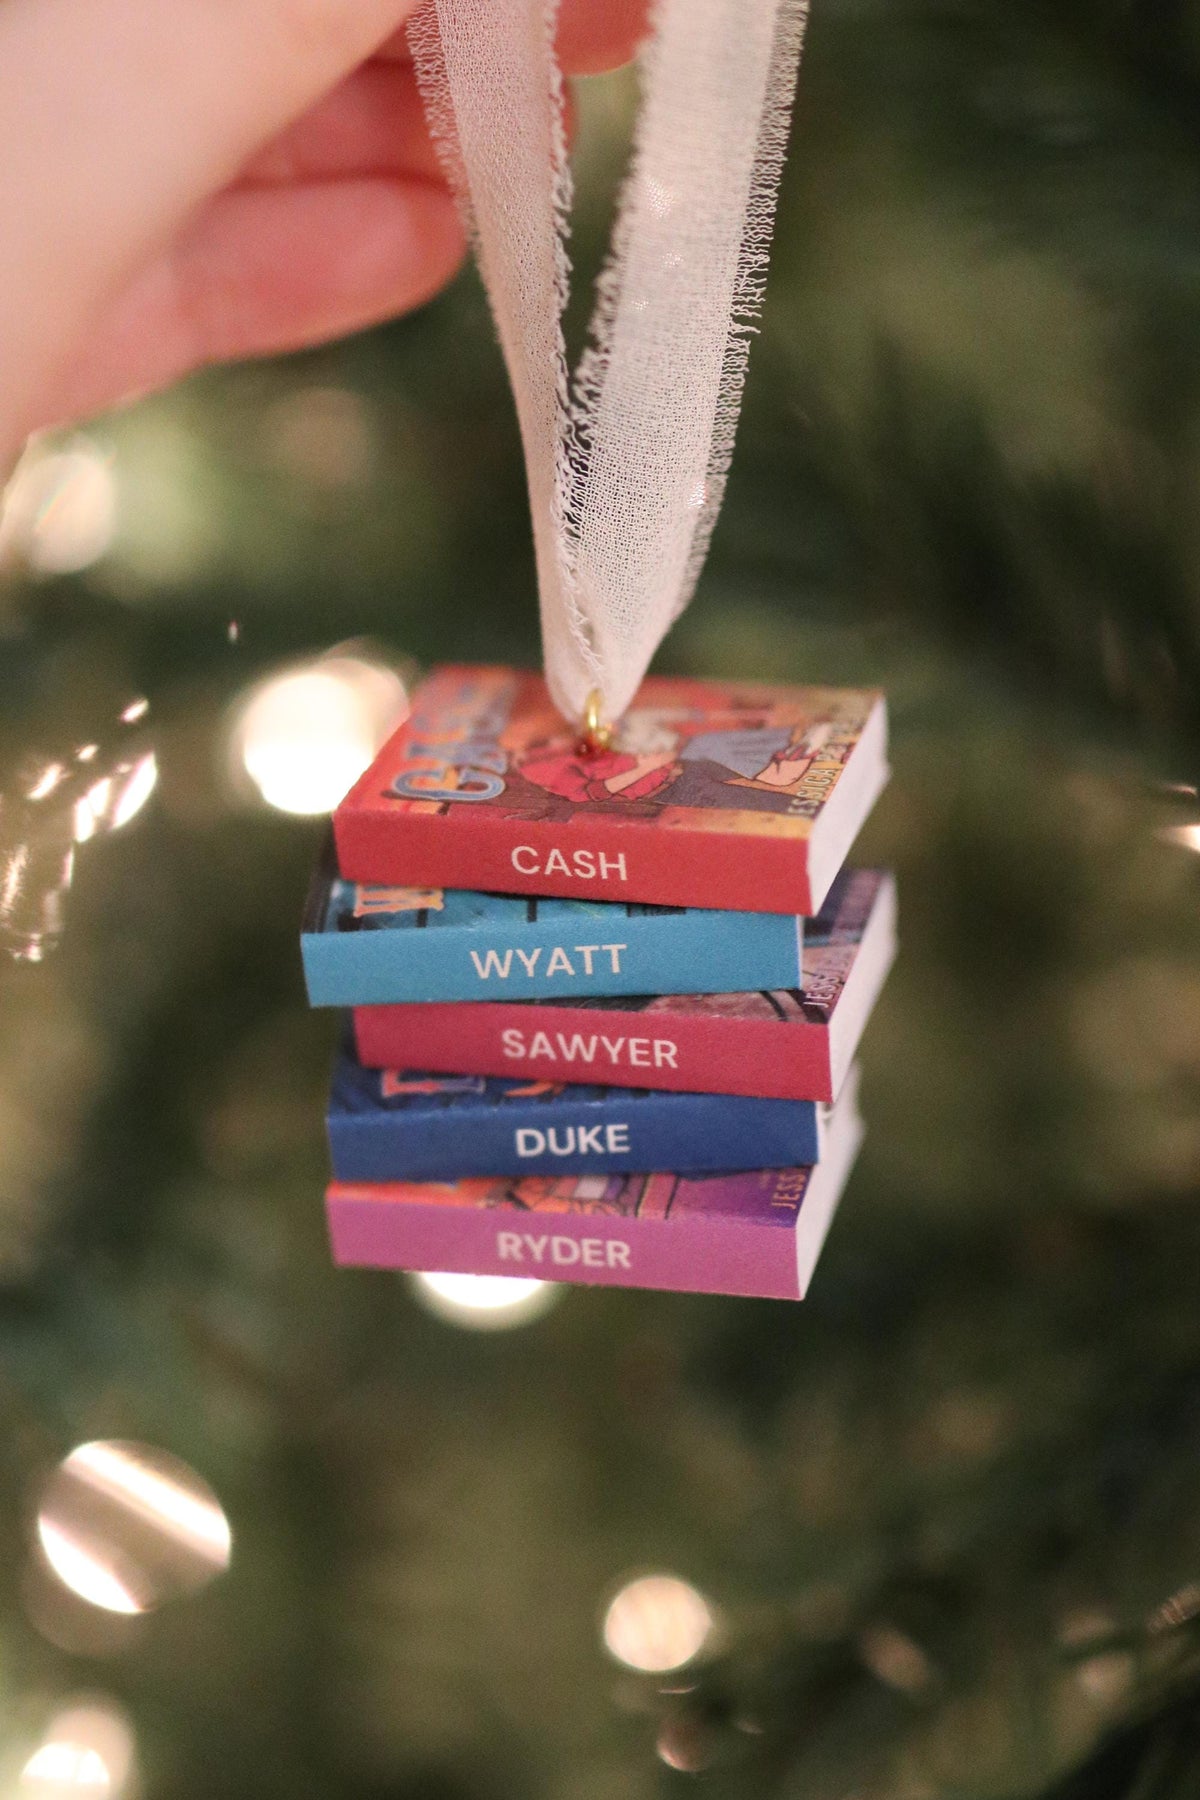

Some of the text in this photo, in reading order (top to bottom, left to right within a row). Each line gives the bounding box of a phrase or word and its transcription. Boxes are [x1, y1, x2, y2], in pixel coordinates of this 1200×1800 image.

[510, 844, 629, 882] CASH
[469, 943, 628, 980] WYATT
[501, 1028, 679, 1070] SAWYER
[514, 1124, 631, 1158] DUKE
[496, 1231, 632, 1269] RYDER
